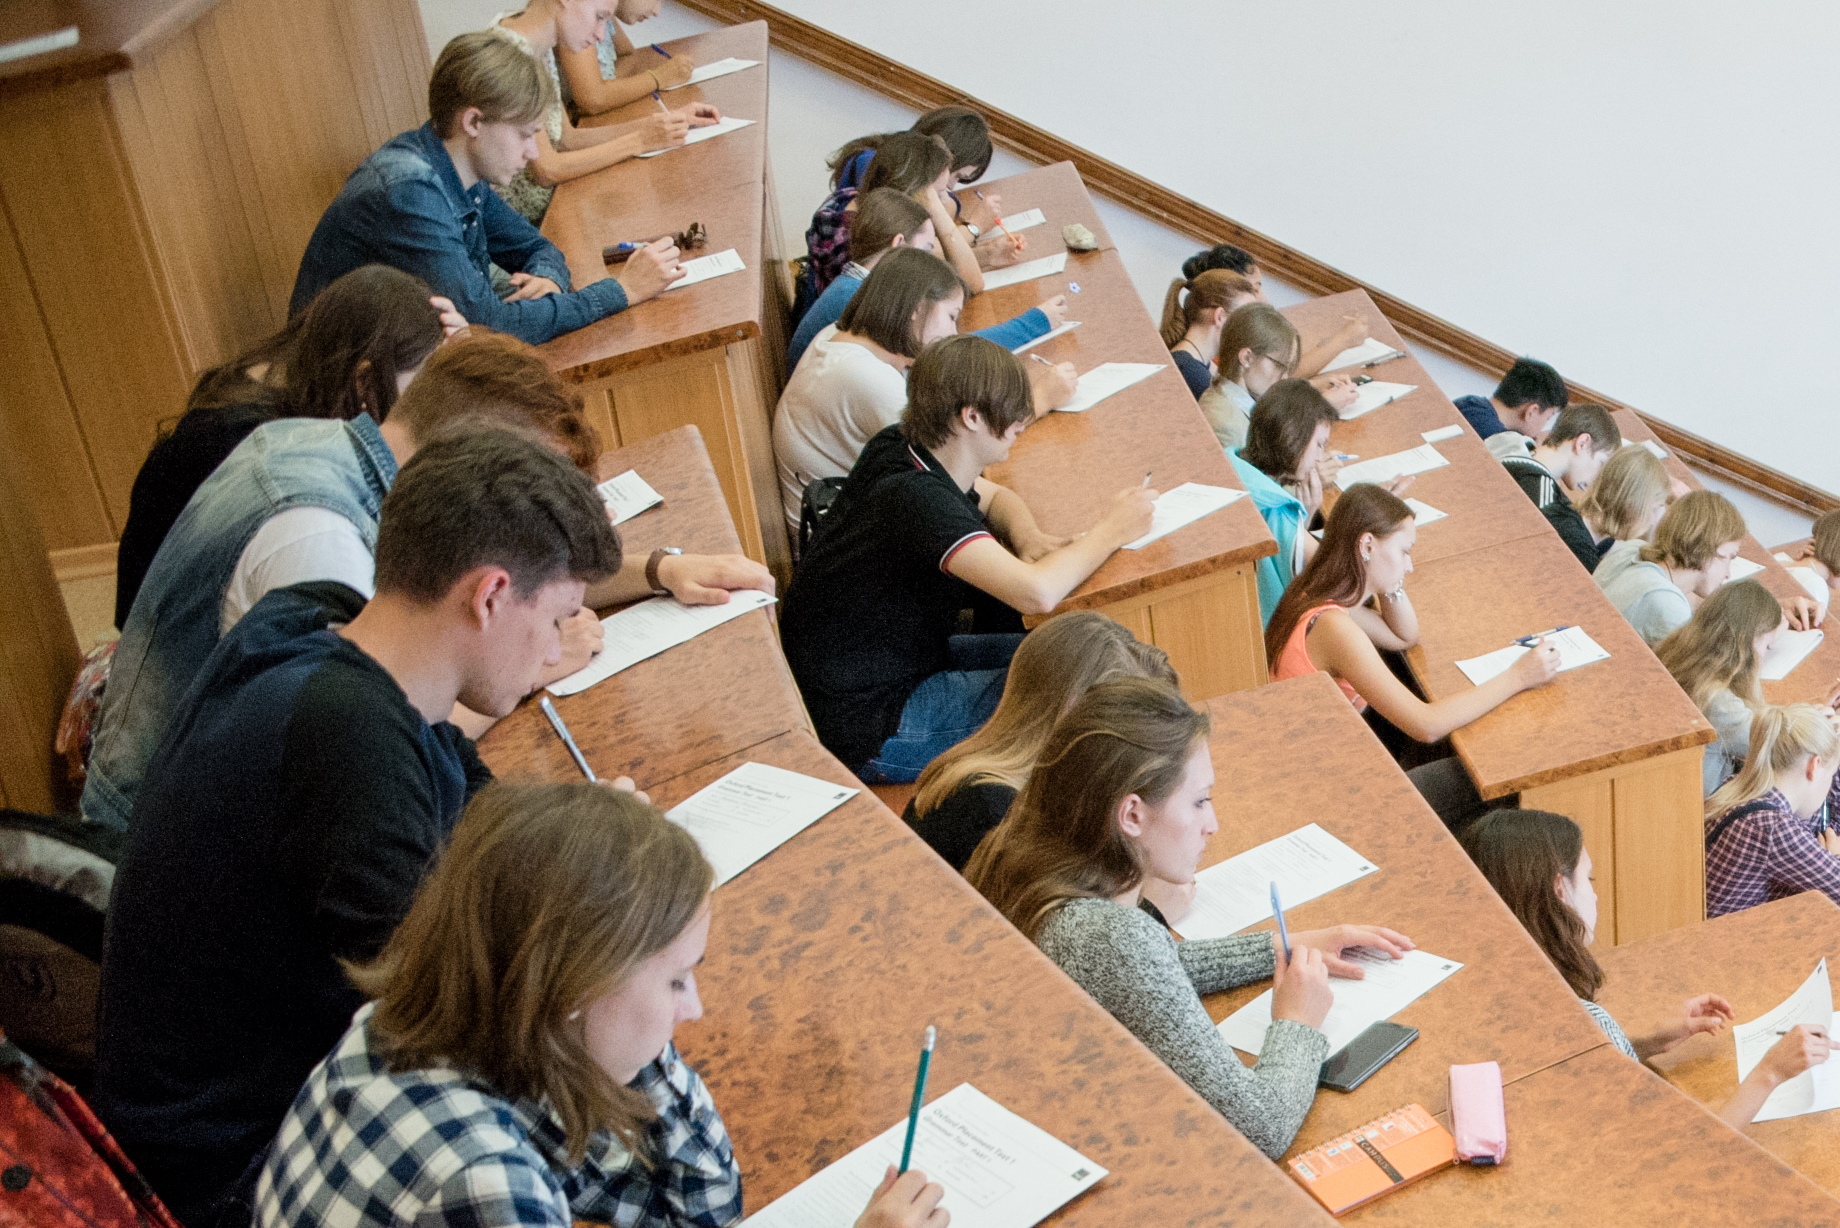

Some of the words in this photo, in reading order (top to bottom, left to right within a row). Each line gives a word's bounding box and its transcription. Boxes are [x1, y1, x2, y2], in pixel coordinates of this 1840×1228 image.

[957, 1122, 995, 1152] Placement
[992, 1145, 1011, 1163] Test
[1360, 1141, 1390, 1171] CAMPUS
